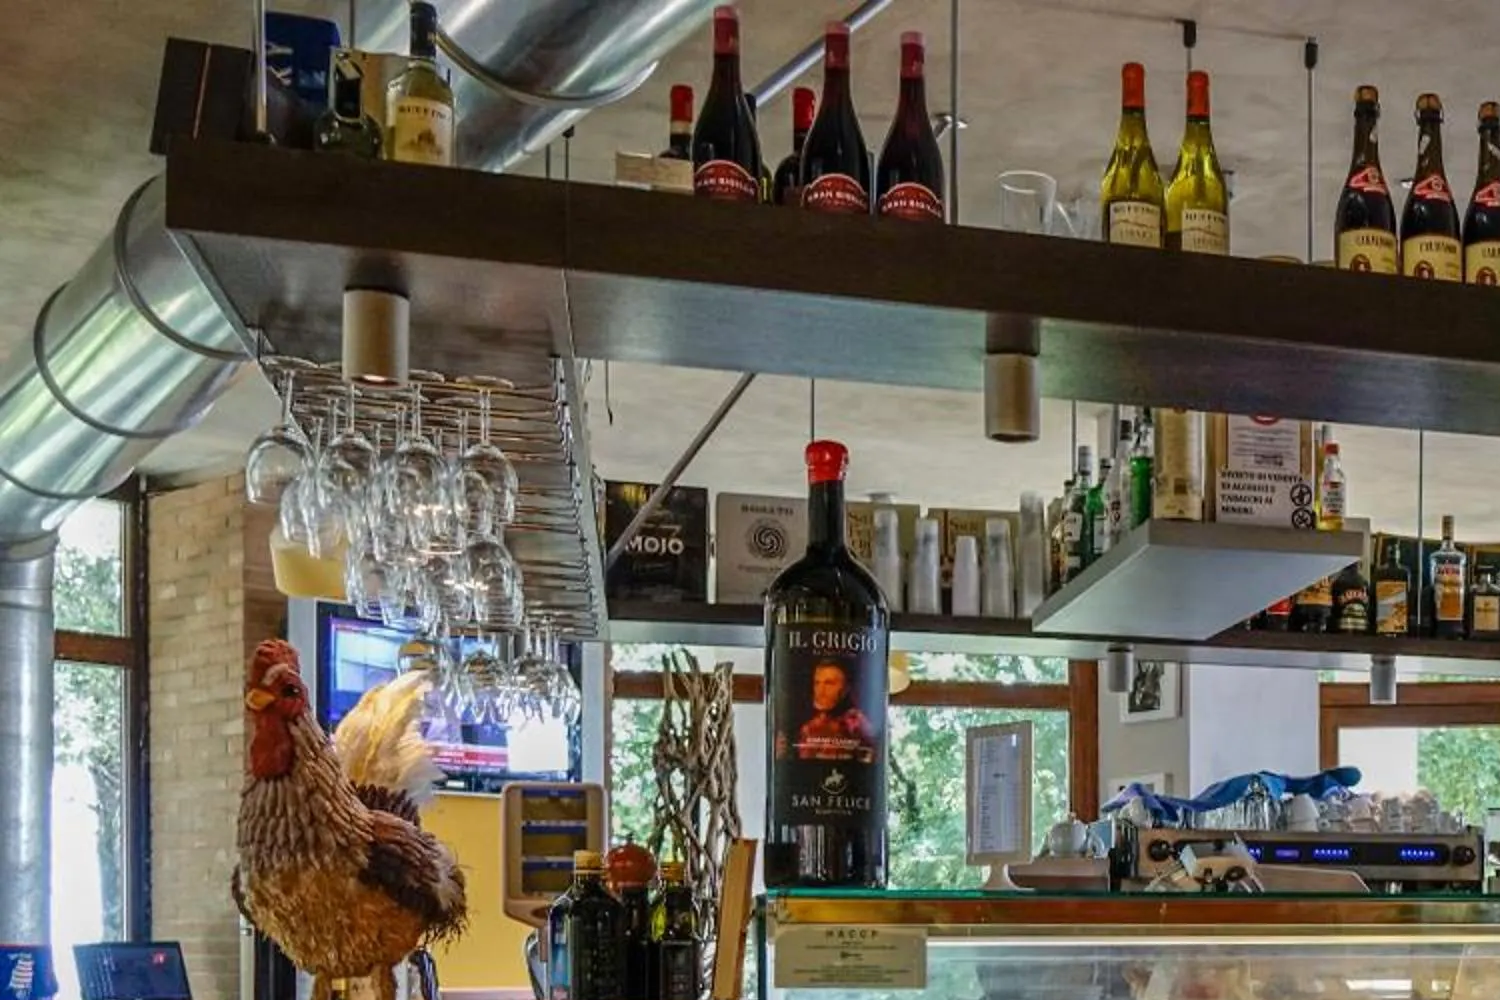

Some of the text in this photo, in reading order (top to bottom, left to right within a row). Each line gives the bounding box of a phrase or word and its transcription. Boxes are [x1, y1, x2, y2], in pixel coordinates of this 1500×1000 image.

[625, 535, 685, 556] MOJO
[788, 631, 808, 649] IL
[812, 630, 878, 653] GRIGIO
[791, 793, 821, 807] SAN
